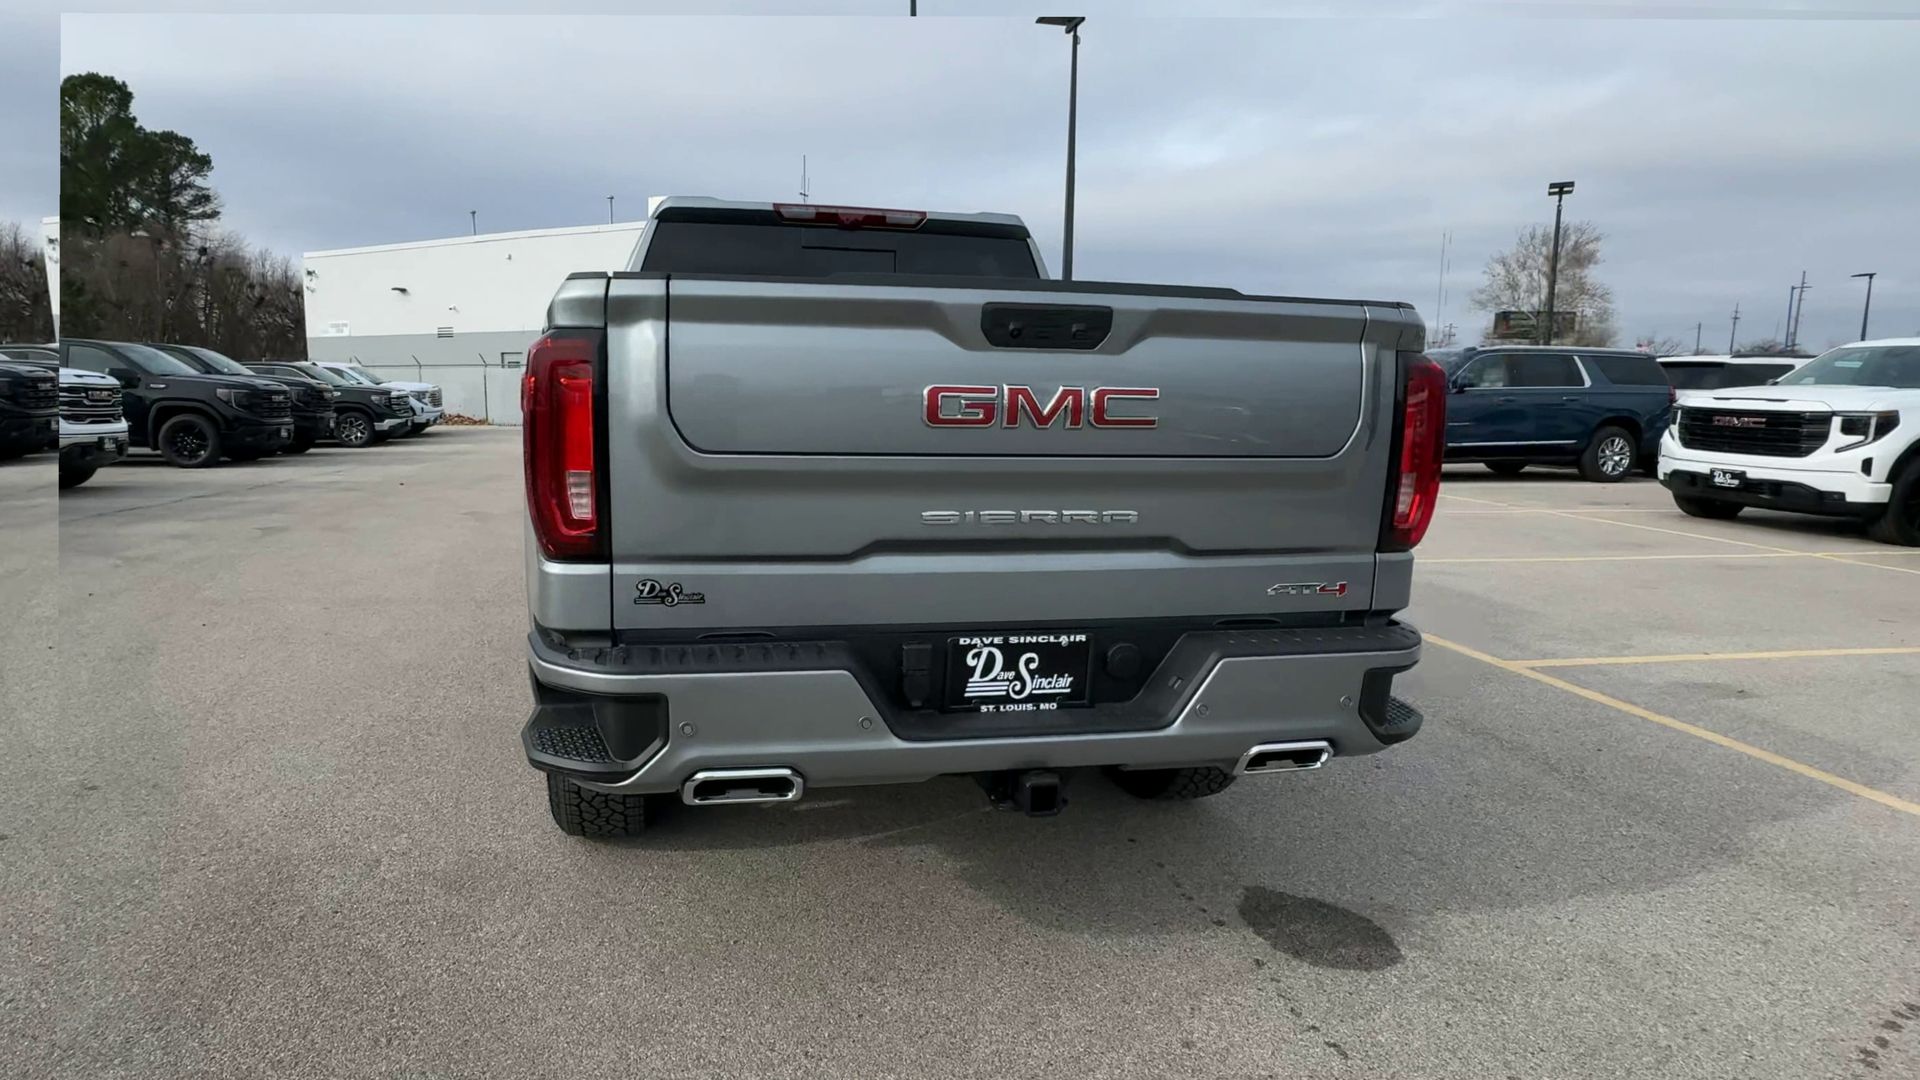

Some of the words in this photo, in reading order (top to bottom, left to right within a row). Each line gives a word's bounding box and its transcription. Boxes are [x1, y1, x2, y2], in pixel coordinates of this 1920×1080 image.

[922, 384, 1160, 429] GMC
[921, 510, 1139, 525] SIERRA
[1267, 581, 1347, 597] AT4
[959, 636, 1004, 646] DAVE
[1008, 634, 1087, 644] SINCLAIR
[966, 646, 1016, 682] Dave
[1008, 652, 1074, 699] Sinclair
[980, 704, 997, 713] ST.
[1040, 702, 1057, 711] MO
